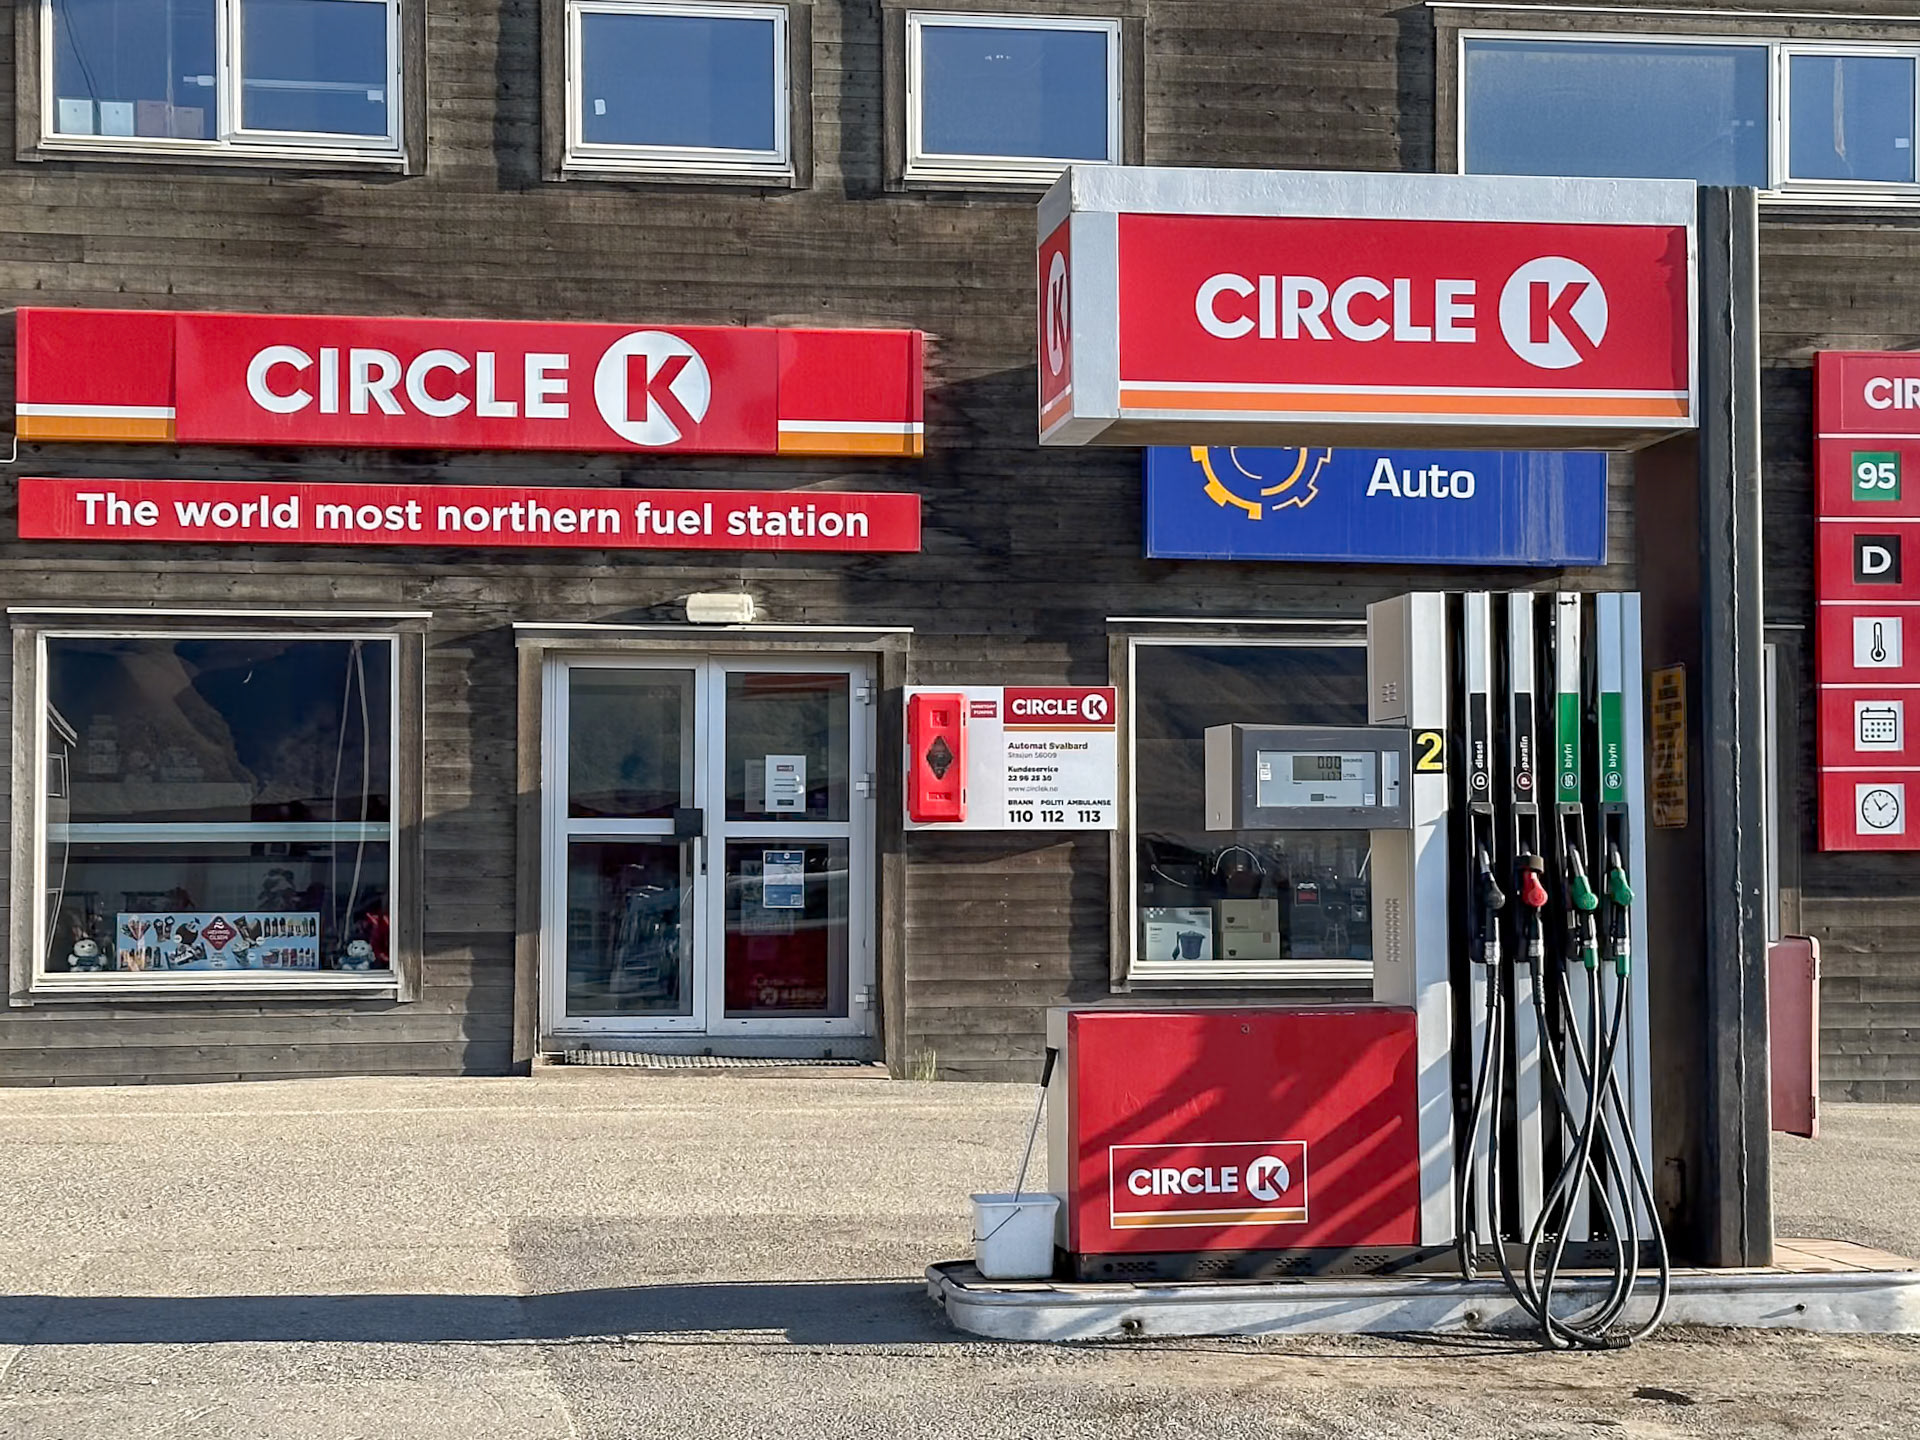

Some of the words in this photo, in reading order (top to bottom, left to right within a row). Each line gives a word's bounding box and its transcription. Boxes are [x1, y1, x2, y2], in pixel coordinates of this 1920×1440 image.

[1196, 274, 1476, 342] CIRCLE
[247, 346, 569, 418] CIRCLE
[1864, 378, 1920, 409] CIR
[1367, 458, 1474, 498] Auto
[1858, 463, 1895, 488] 95
[77, 493, 158, 526] The
[174, 496, 298, 528] world
[316, 501, 421, 530] most
[438, 500, 620, 533] northern
[635, 502, 712, 534] fuel
[728, 505, 868, 536] station
[1863, 546, 1891, 573] D
[1012, 699, 1077, 714] CIRCLE
[1416, 732, 1443, 770] 2
[1475, 741, 1483, 769] diesel
[1564, 744, 1572, 768] blyfri
[1609, 744, 1618, 768] blyfri
[1009, 810, 1033, 822] 110
[1041, 810, 1064, 822] 112
[1078, 810, 1100, 822] 113
[1128, 1167, 1238, 1195] CIRCLE
